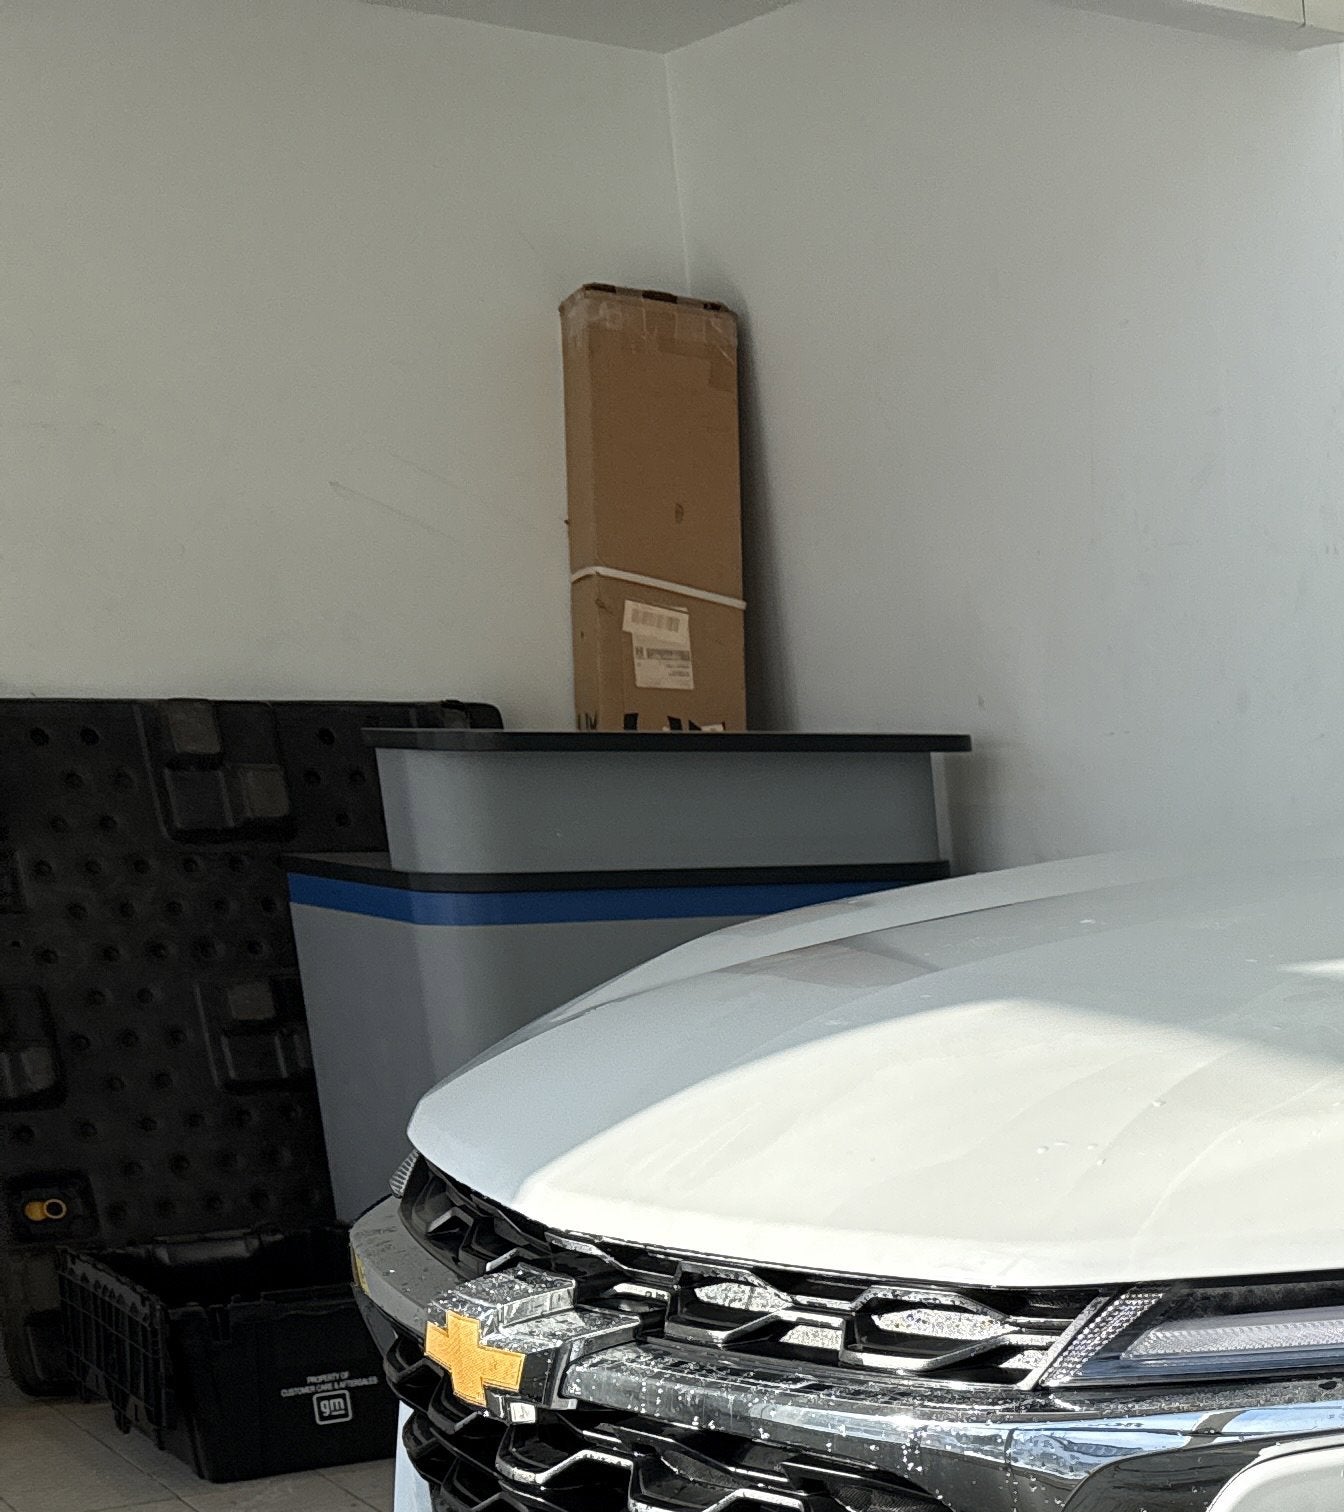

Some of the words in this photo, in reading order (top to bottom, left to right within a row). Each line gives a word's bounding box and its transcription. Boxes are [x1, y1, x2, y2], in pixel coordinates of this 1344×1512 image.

[280, 1386, 315, 1398] CUSTOMER
[316, 1383, 333, 1392] CARE
[340, 1376, 379, 1388] AFTERSALES
[306, 1372, 340, 1384] PROPERTY
[340, 1371, 350, 1379] OF
[319, 1398, 346, 1417] gm
